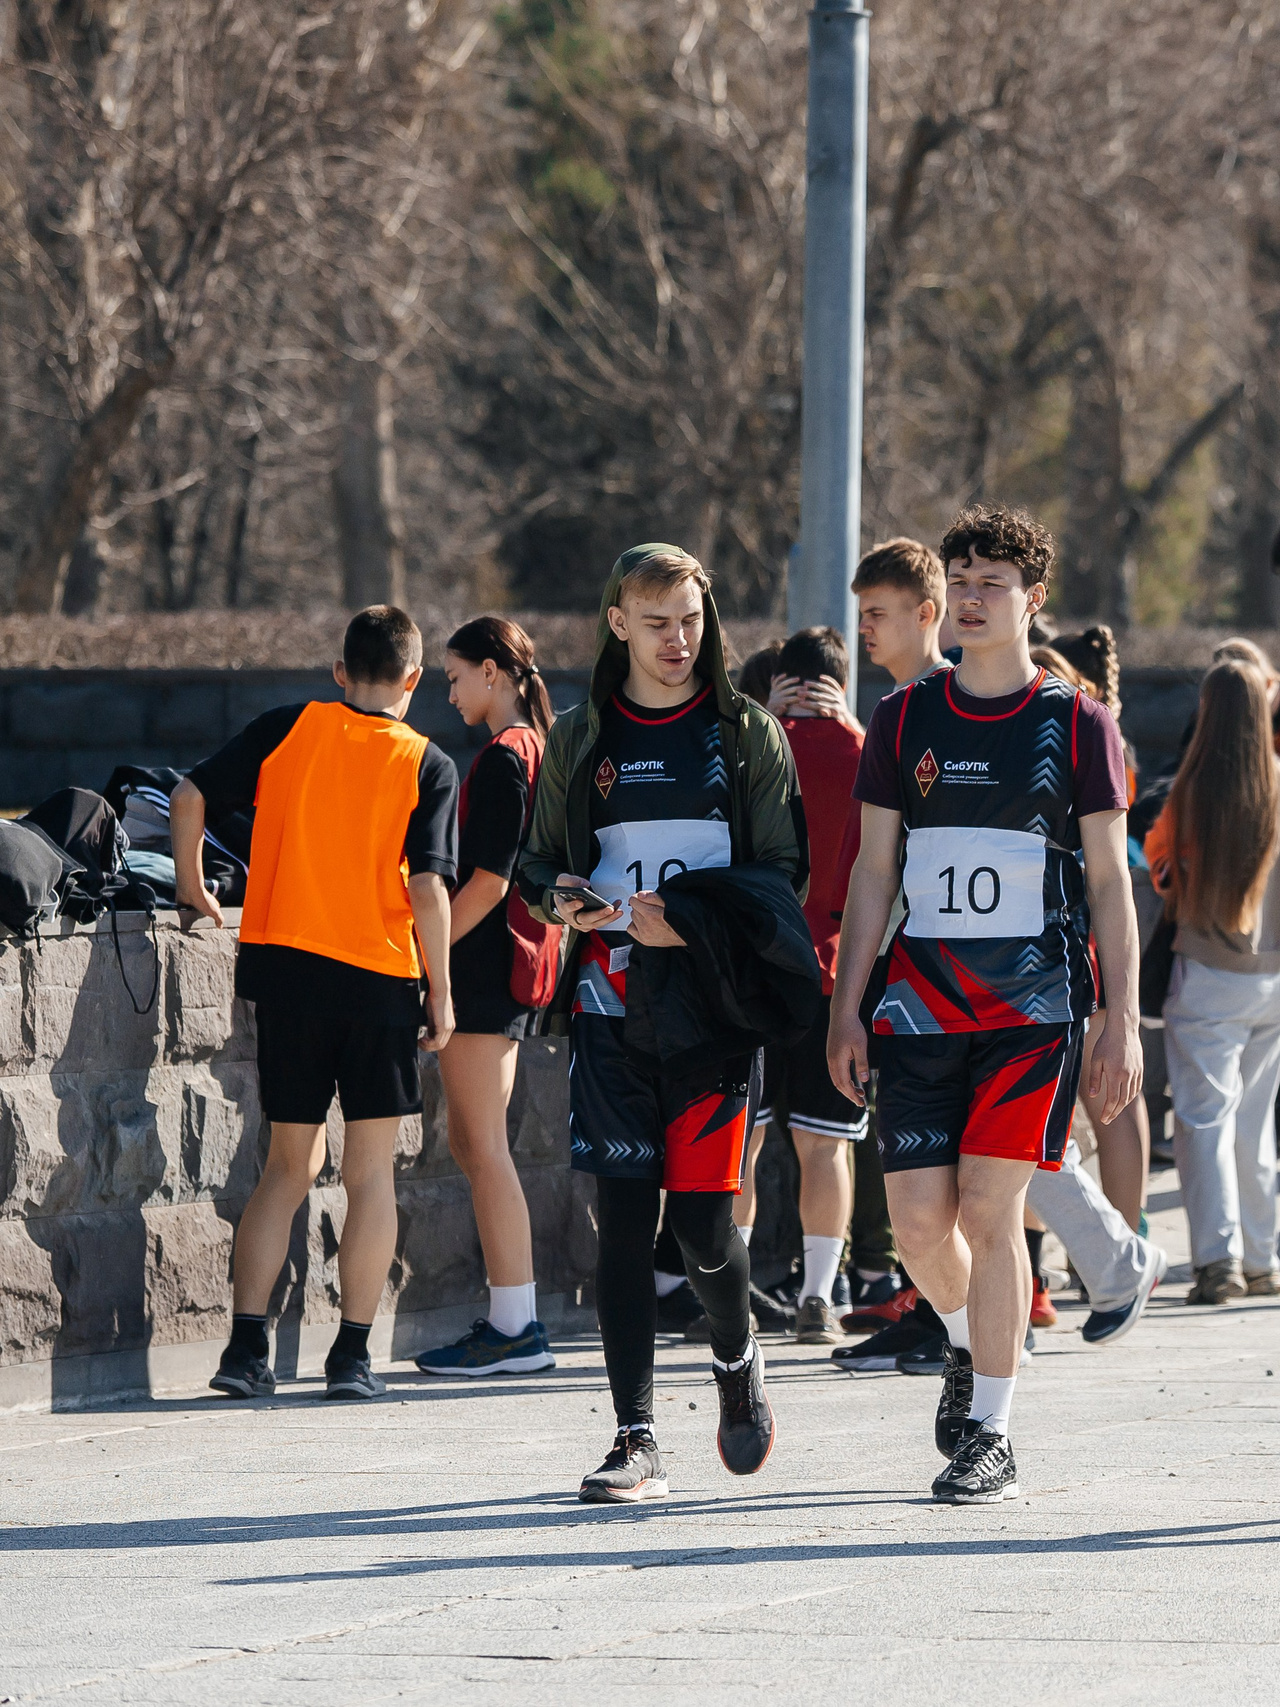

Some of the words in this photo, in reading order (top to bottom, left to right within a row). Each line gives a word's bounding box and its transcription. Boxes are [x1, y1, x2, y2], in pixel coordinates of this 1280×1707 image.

[620, 760, 665, 772] СибУПК
[943, 760, 990, 772] СибУПК
[938, 865, 1001, 915] 10
